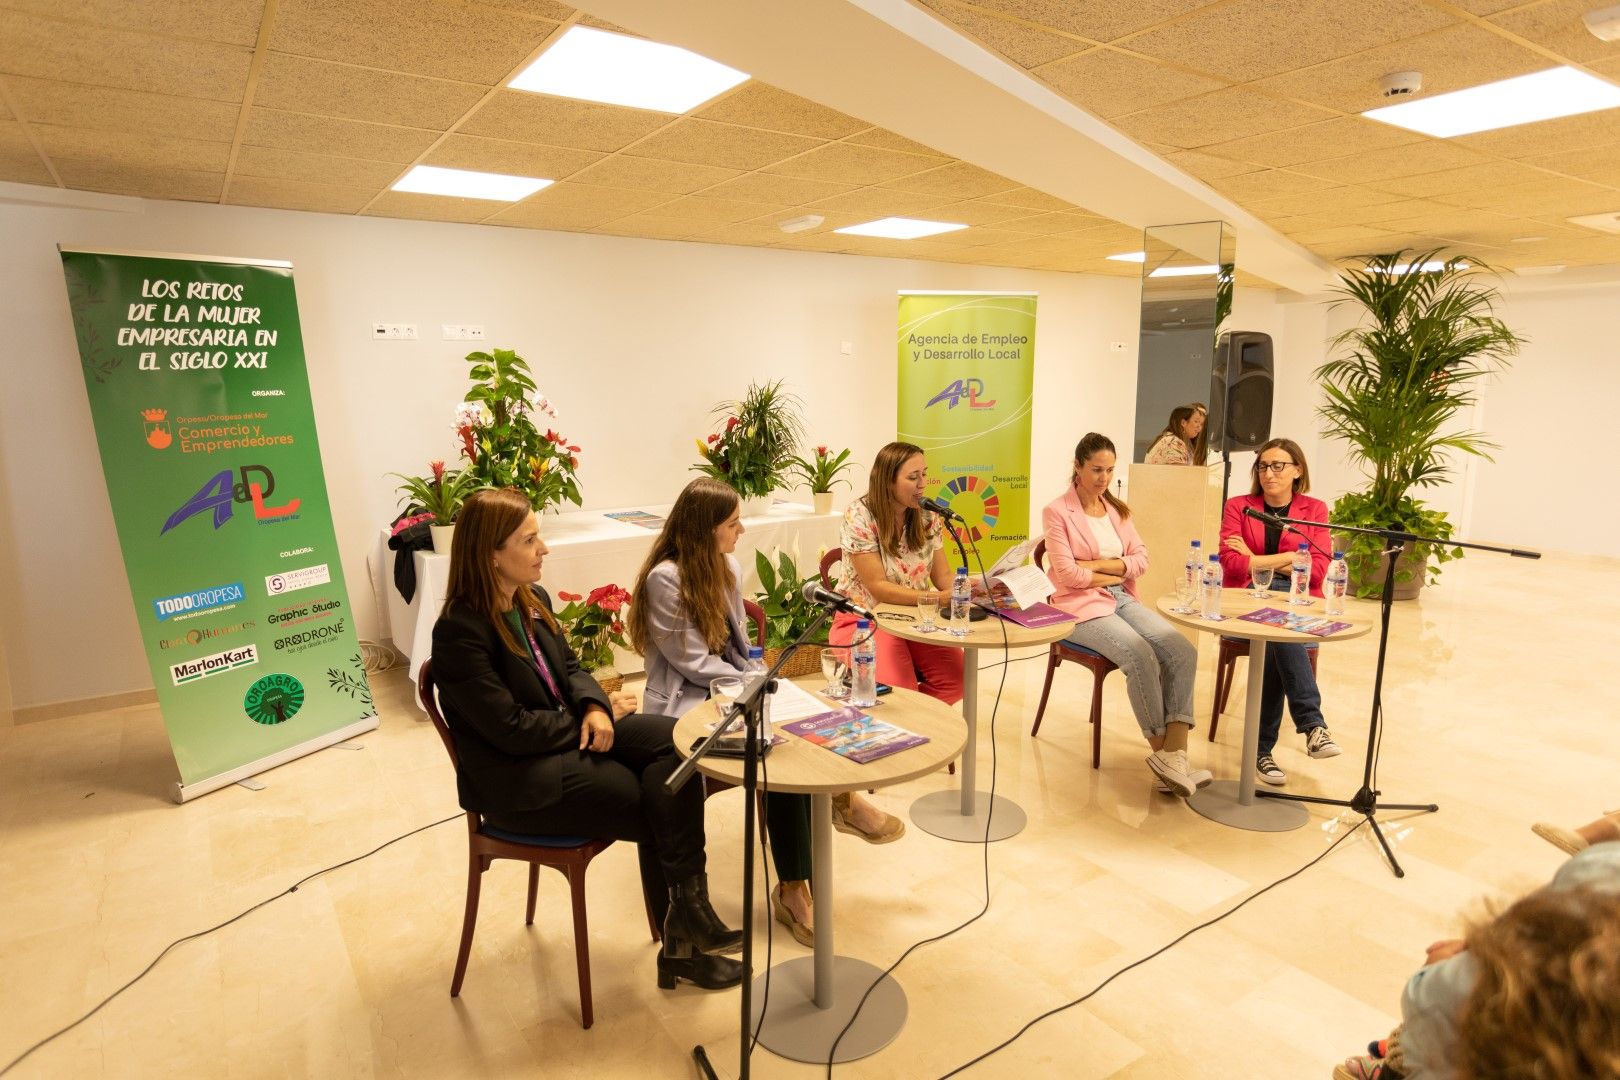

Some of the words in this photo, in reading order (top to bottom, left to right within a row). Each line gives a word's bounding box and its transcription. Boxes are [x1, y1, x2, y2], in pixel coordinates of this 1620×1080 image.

[142, 279, 180, 299] LOS
[186, 281, 244, 301] RETOS
[128, 304, 157, 322] DE
[164, 304, 190, 323] LA
[197, 306, 261, 326] MUJER
[117, 327, 248, 347] EMPRESARIA
[255, 329, 278, 347] EN
[908, 333, 959, 347] Agencia
[962, 333, 977, 345] de
[981, 333, 1028, 347] Empleo
[139, 352, 161, 371] EL
[169, 351, 228, 371] SIGLO
[234, 351, 268, 369] XXI
[913, 350, 920, 362] y
[924, 349, 985, 360] Desarrollo
[988, 348, 1021, 360] Local
[251, 389, 286, 398] ORGANIZA:
[178, 424, 250, 440] Comercio
[252, 426, 261, 437] y
[181, 434, 294, 454] Emprendedores
[992, 475, 1028, 483] Desarrollo
[279, 546, 316, 559] COLABORA:
[156, 586, 243, 616] TODOOROPESA
[267, 608, 309, 624] Graphic
[311, 600, 341, 614] Studio
[173, 647, 255, 678] MarlonKart
[246, 675, 299, 704] OROAGRO
